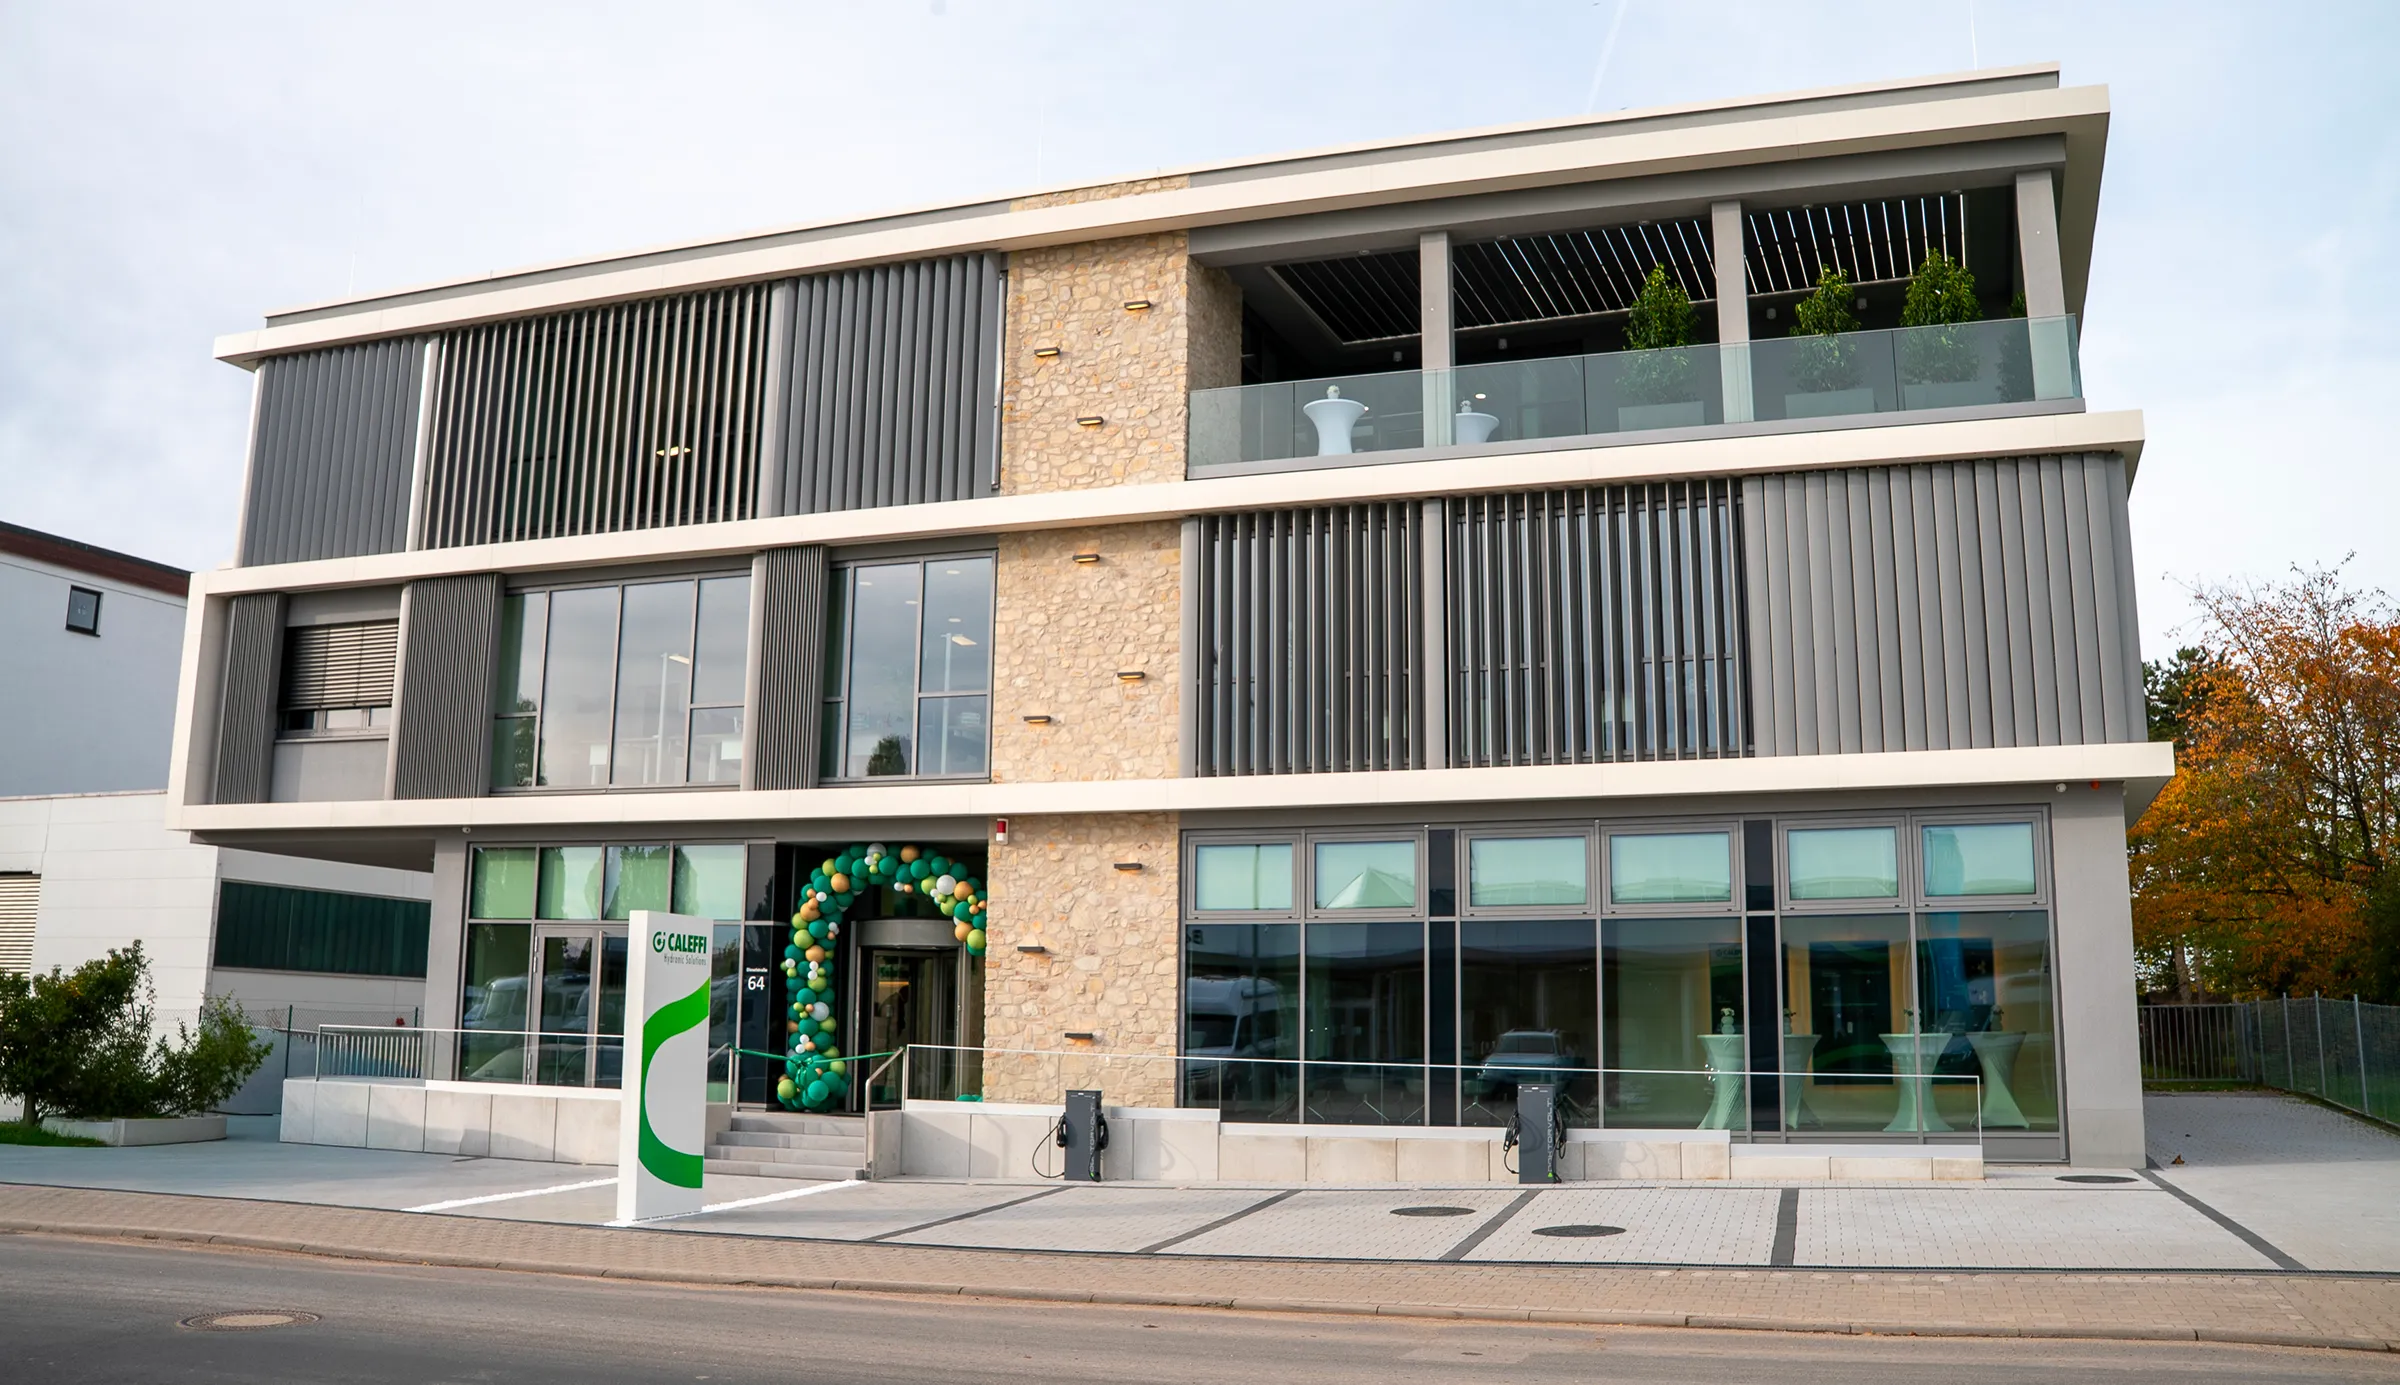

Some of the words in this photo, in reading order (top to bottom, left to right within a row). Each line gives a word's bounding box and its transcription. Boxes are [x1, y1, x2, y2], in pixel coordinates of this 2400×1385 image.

[668, 933, 707, 954] CALEFFI
[664, 953, 685, 965] Hydronic
[686, 954, 707, 965] Solutions
[748, 976, 765, 990] 64
